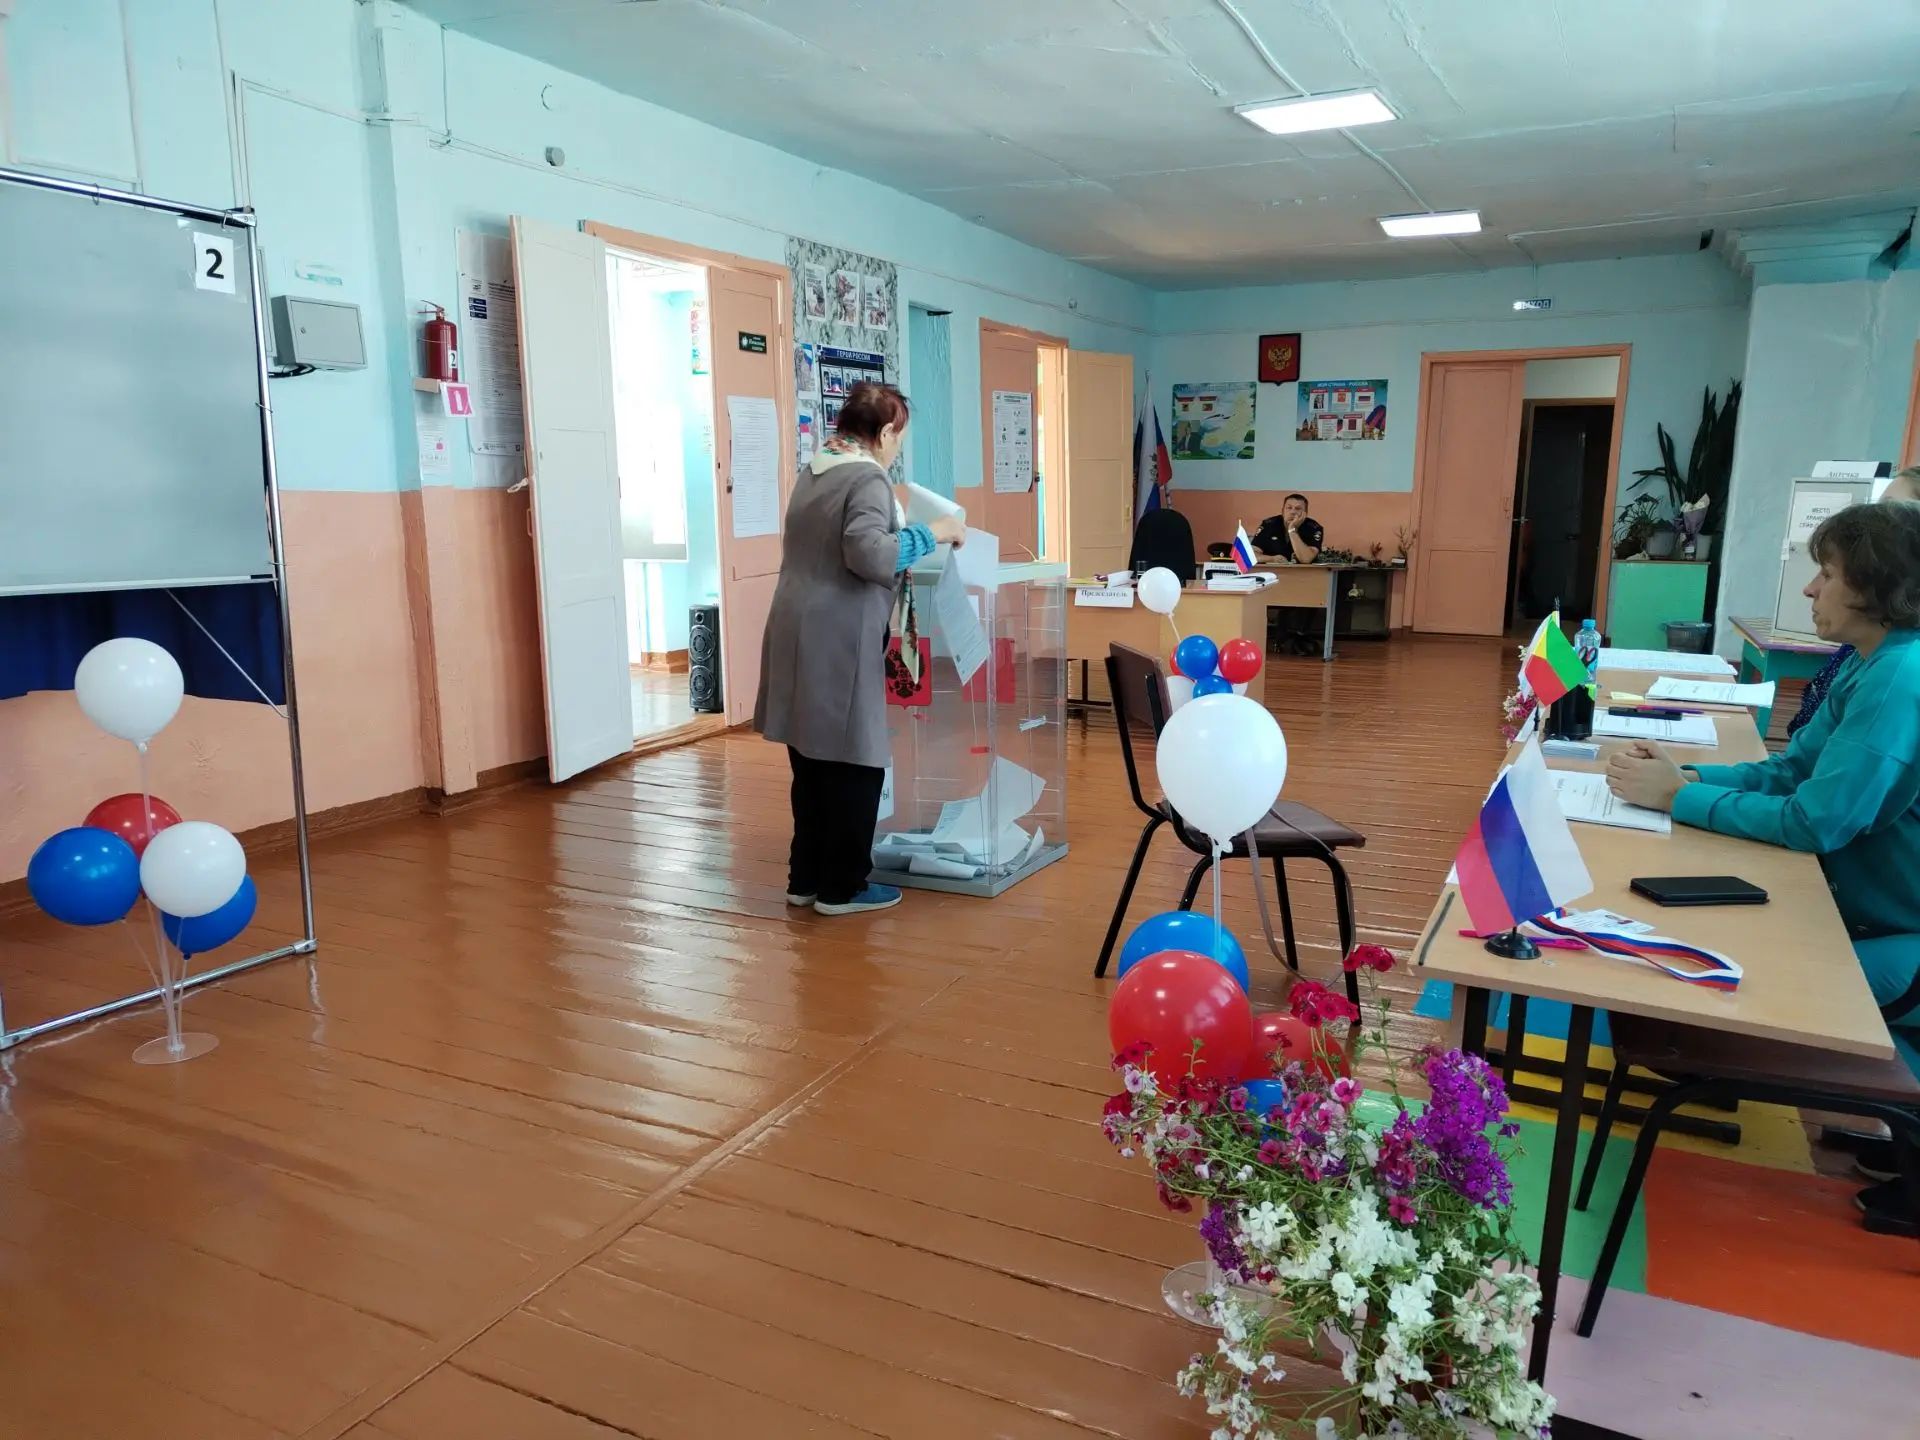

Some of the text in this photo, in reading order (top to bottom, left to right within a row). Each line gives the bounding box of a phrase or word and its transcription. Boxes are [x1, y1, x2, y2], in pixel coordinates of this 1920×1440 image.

[206, 248, 224, 279] 2
[450, 352, 456, 367] 2
[1081, 589, 1128, 598] Председатель
